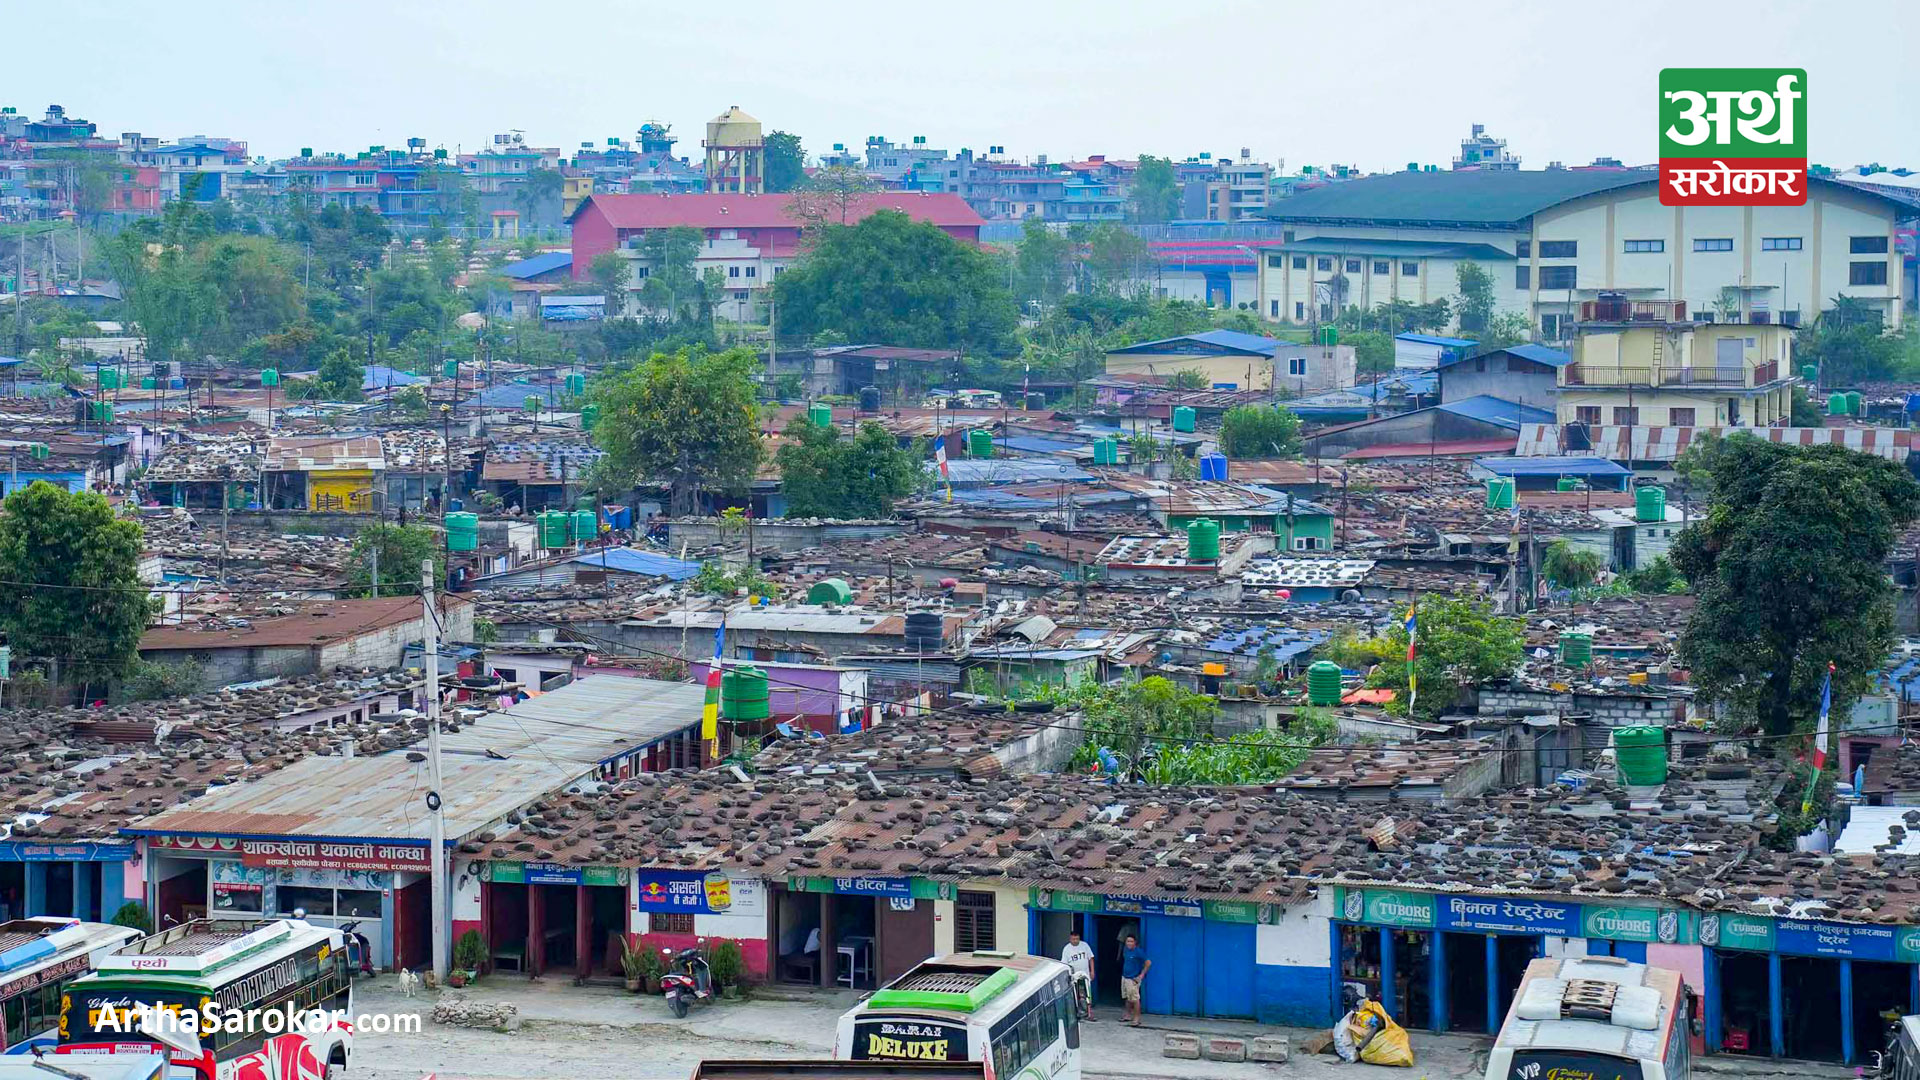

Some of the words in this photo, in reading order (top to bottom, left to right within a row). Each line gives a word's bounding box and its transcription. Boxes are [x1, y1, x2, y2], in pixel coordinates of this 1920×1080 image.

[242, 840, 316, 856] थाकखोला
[320, 842, 375, 859] थकाली
[379, 845, 425, 860] भान्छा
[669, 879, 702, 894] असली
[855, 876, 887, 891] होटल
[1378, 901, 1431, 919] TUBORG
[1597, 916, 1651, 933] TUBORG
[1732, 924, 1768, 935] TUBORG
[868, 1033, 949, 1061] DELUXE
[1516, 1061, 1541, 1080] VIP
